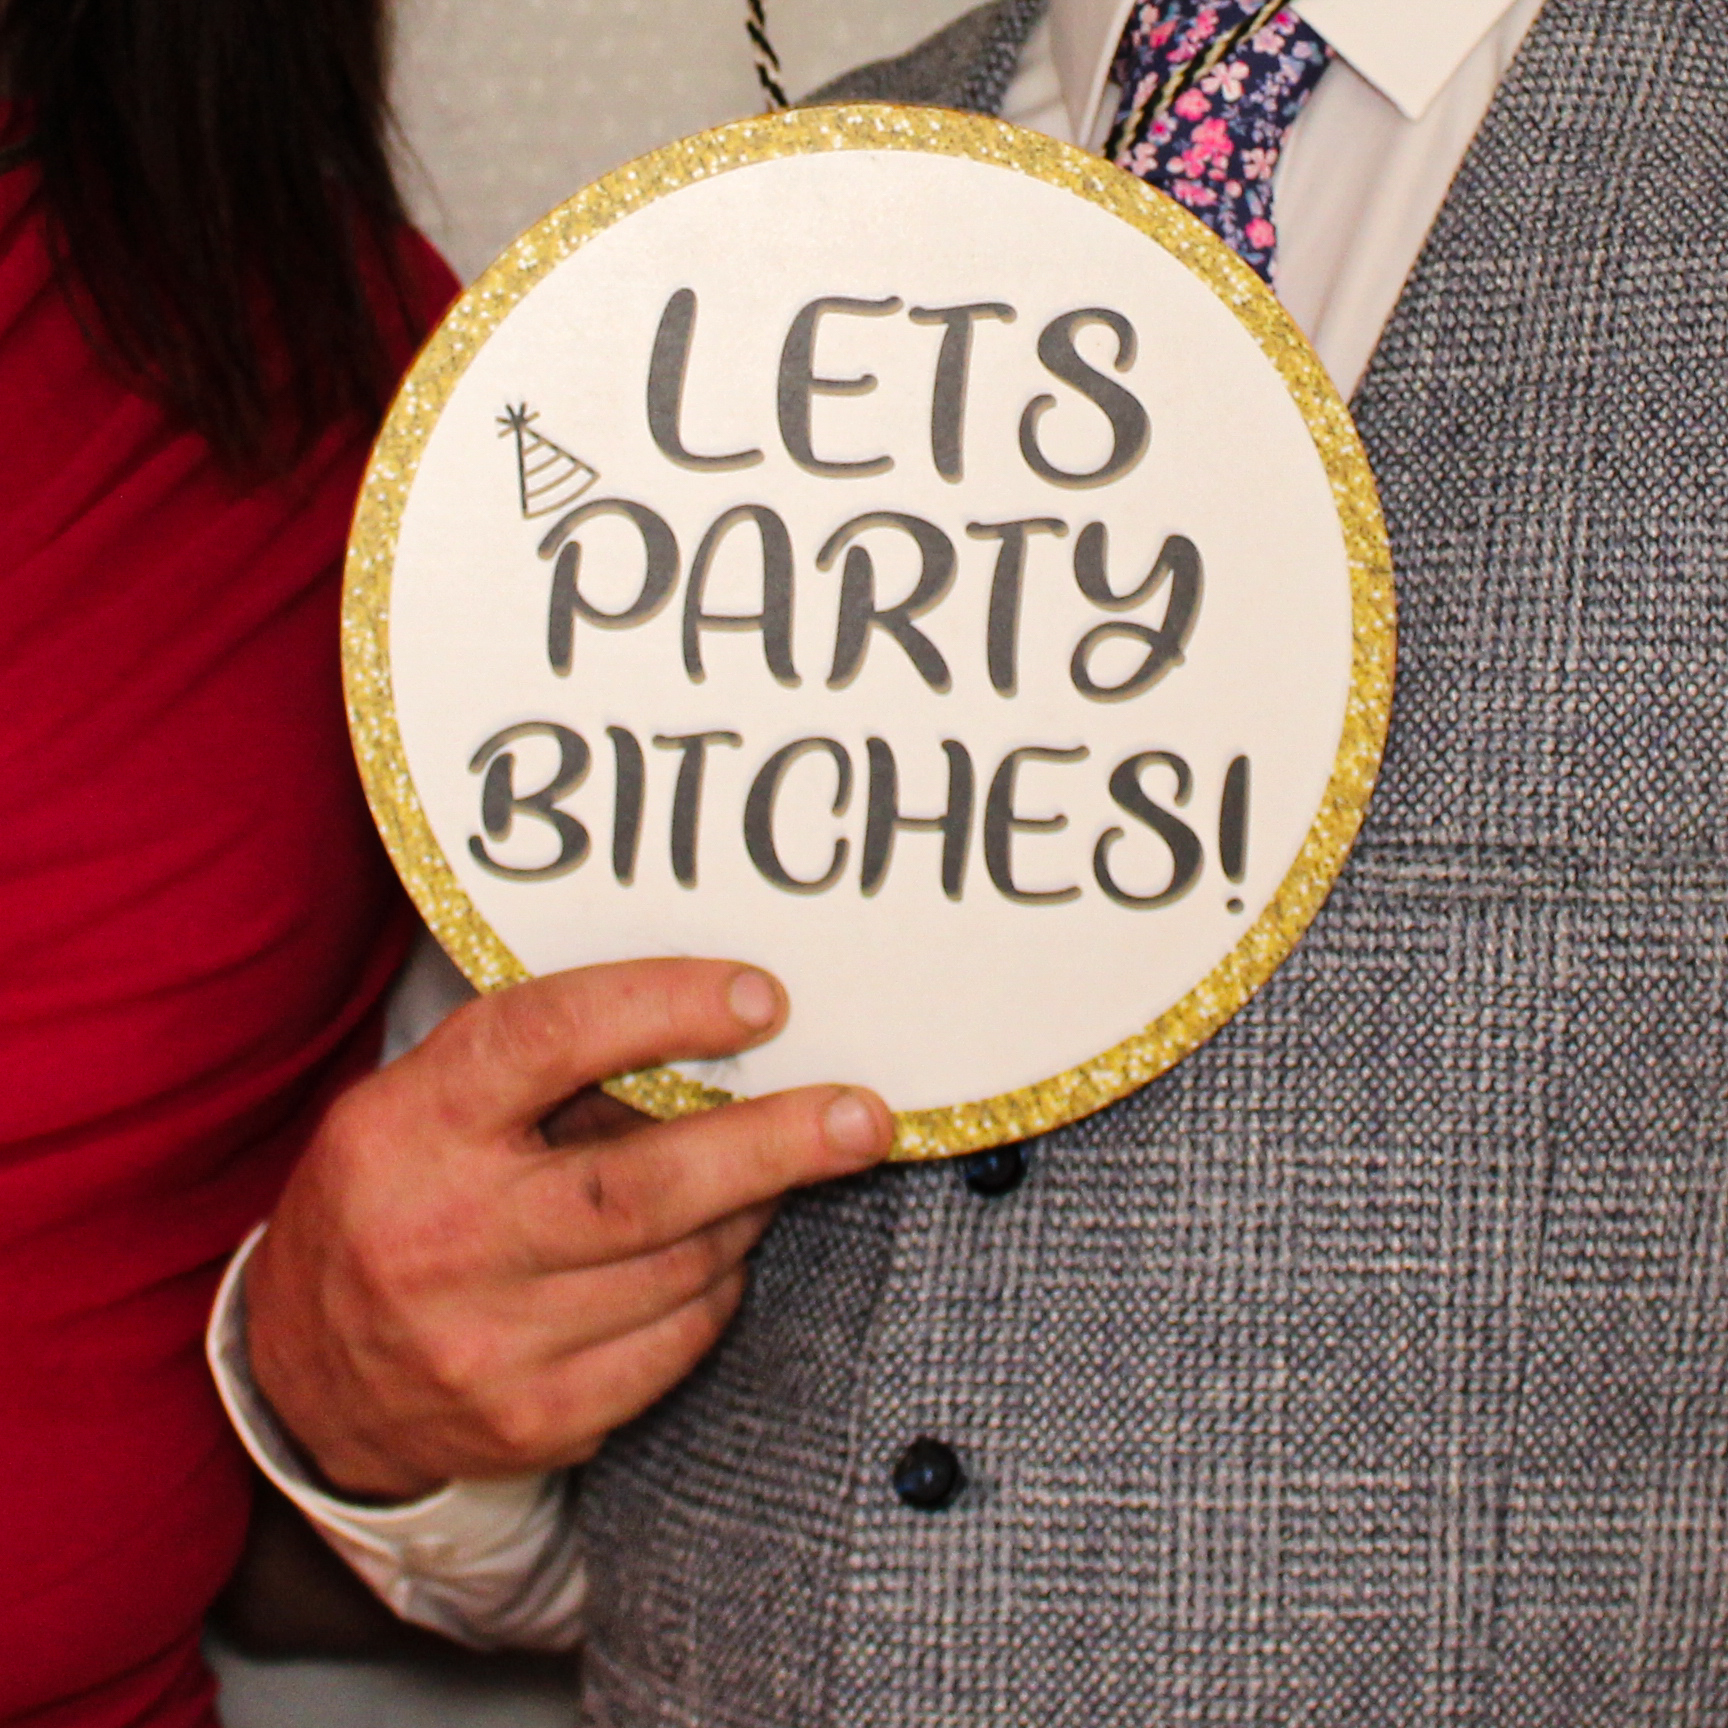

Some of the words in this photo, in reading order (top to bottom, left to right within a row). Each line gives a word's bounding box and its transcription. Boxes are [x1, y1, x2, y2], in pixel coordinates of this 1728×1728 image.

[644, 285, 1152, 490] LETS
[535, 497, 1206, 703] PARTY
[466, 720, 1253, 916] BITCHES!
